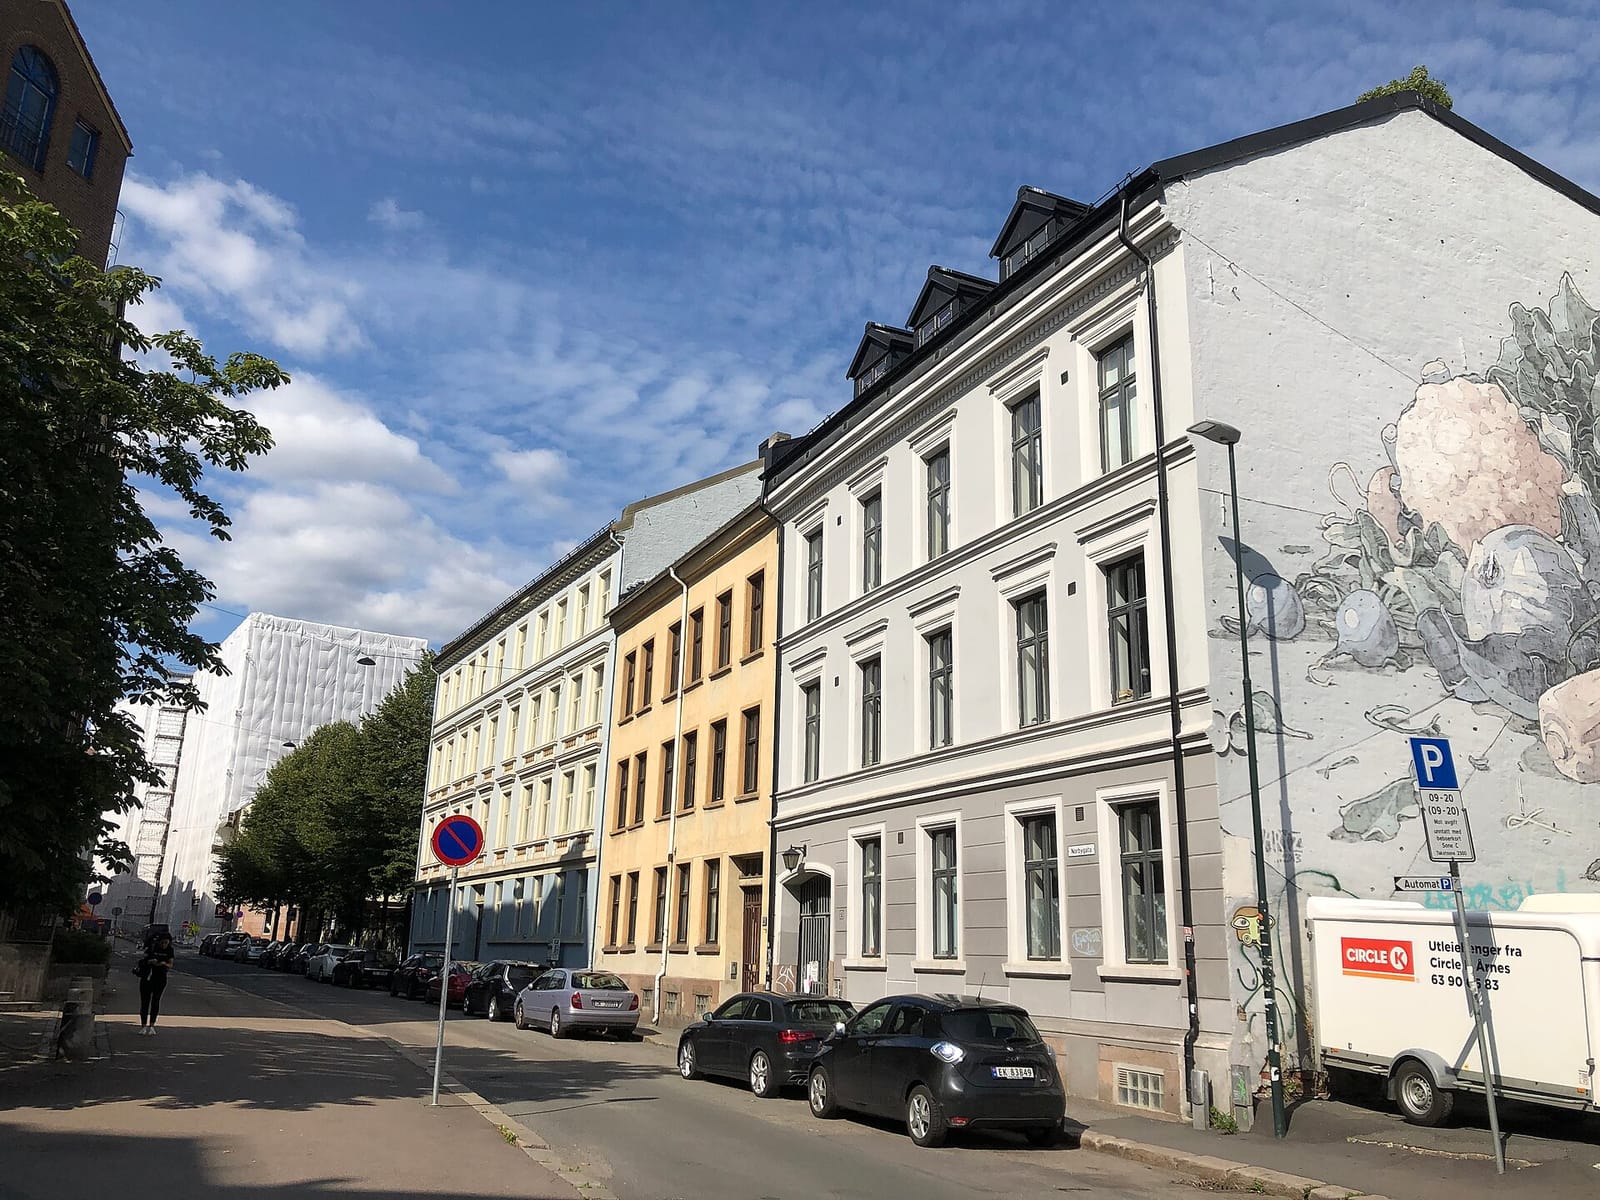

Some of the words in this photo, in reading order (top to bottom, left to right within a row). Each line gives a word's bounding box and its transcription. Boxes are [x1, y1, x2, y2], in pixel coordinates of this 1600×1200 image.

[1421, 745, 1443, 781] P
[1429, 793, 1454, 802] 09-20
[1428, 806, 1459, 816] (09-20)
[1405, 880, 1440, 889] Automat
[1444, 879, 1450, 888] P
[1346, 948, 1388, 964] CIRCLE
[1505, 945, 1522, 957] fra
[1430, 957, 1461, 970] Circle
[1476, 959, 1510, 974] Årnes
[1431, 974, 1444, 985] 63
[1448, 975, 1463, 987] 90
[1485, 979, 1499, 990] 83
